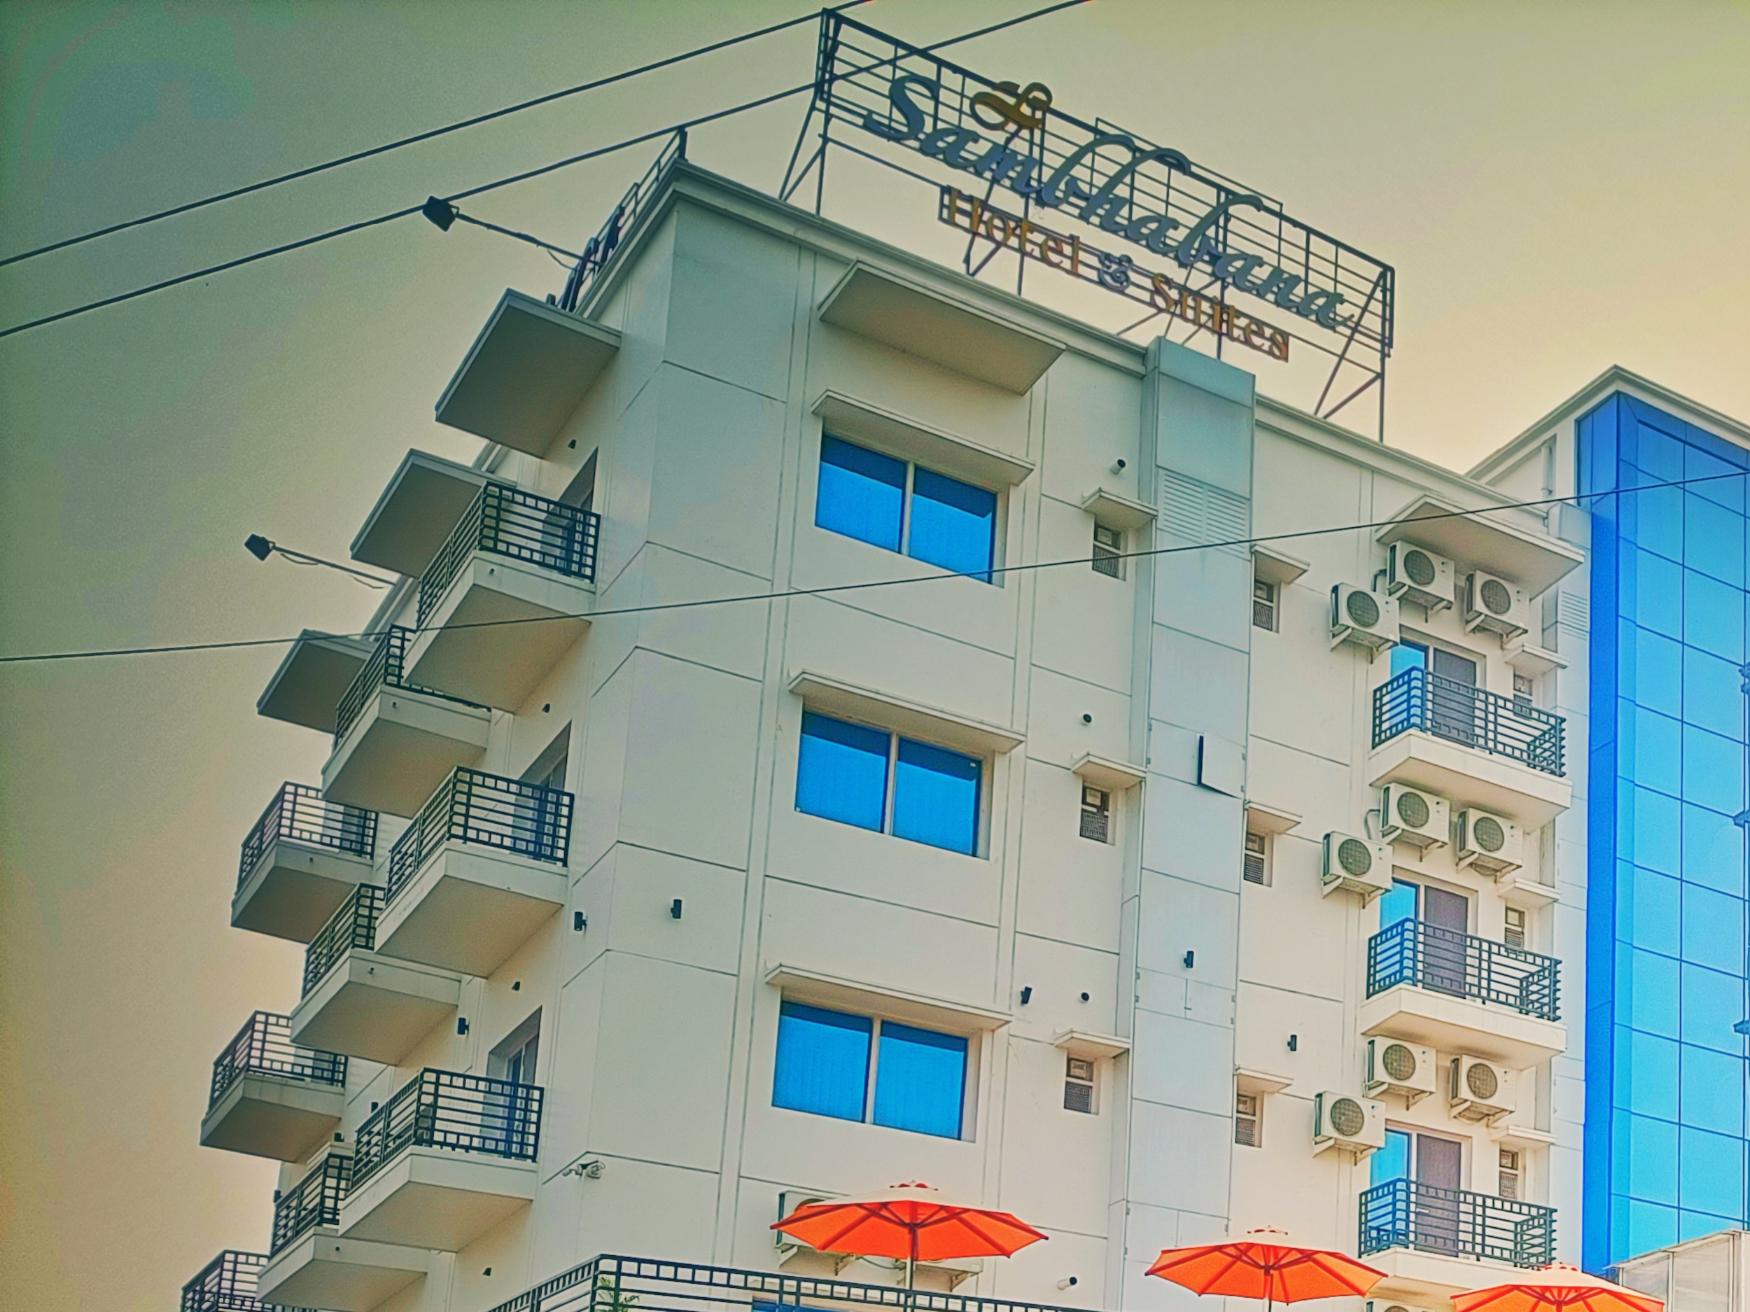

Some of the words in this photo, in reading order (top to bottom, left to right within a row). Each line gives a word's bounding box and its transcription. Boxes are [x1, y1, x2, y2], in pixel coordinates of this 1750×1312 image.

[863, 74, 1355, 329] Sambhabana
[947, 184, 1081, 278] Hotel
[1097, 252, 1134, 292] &
[1150, 272, 1288, 362] Suites
